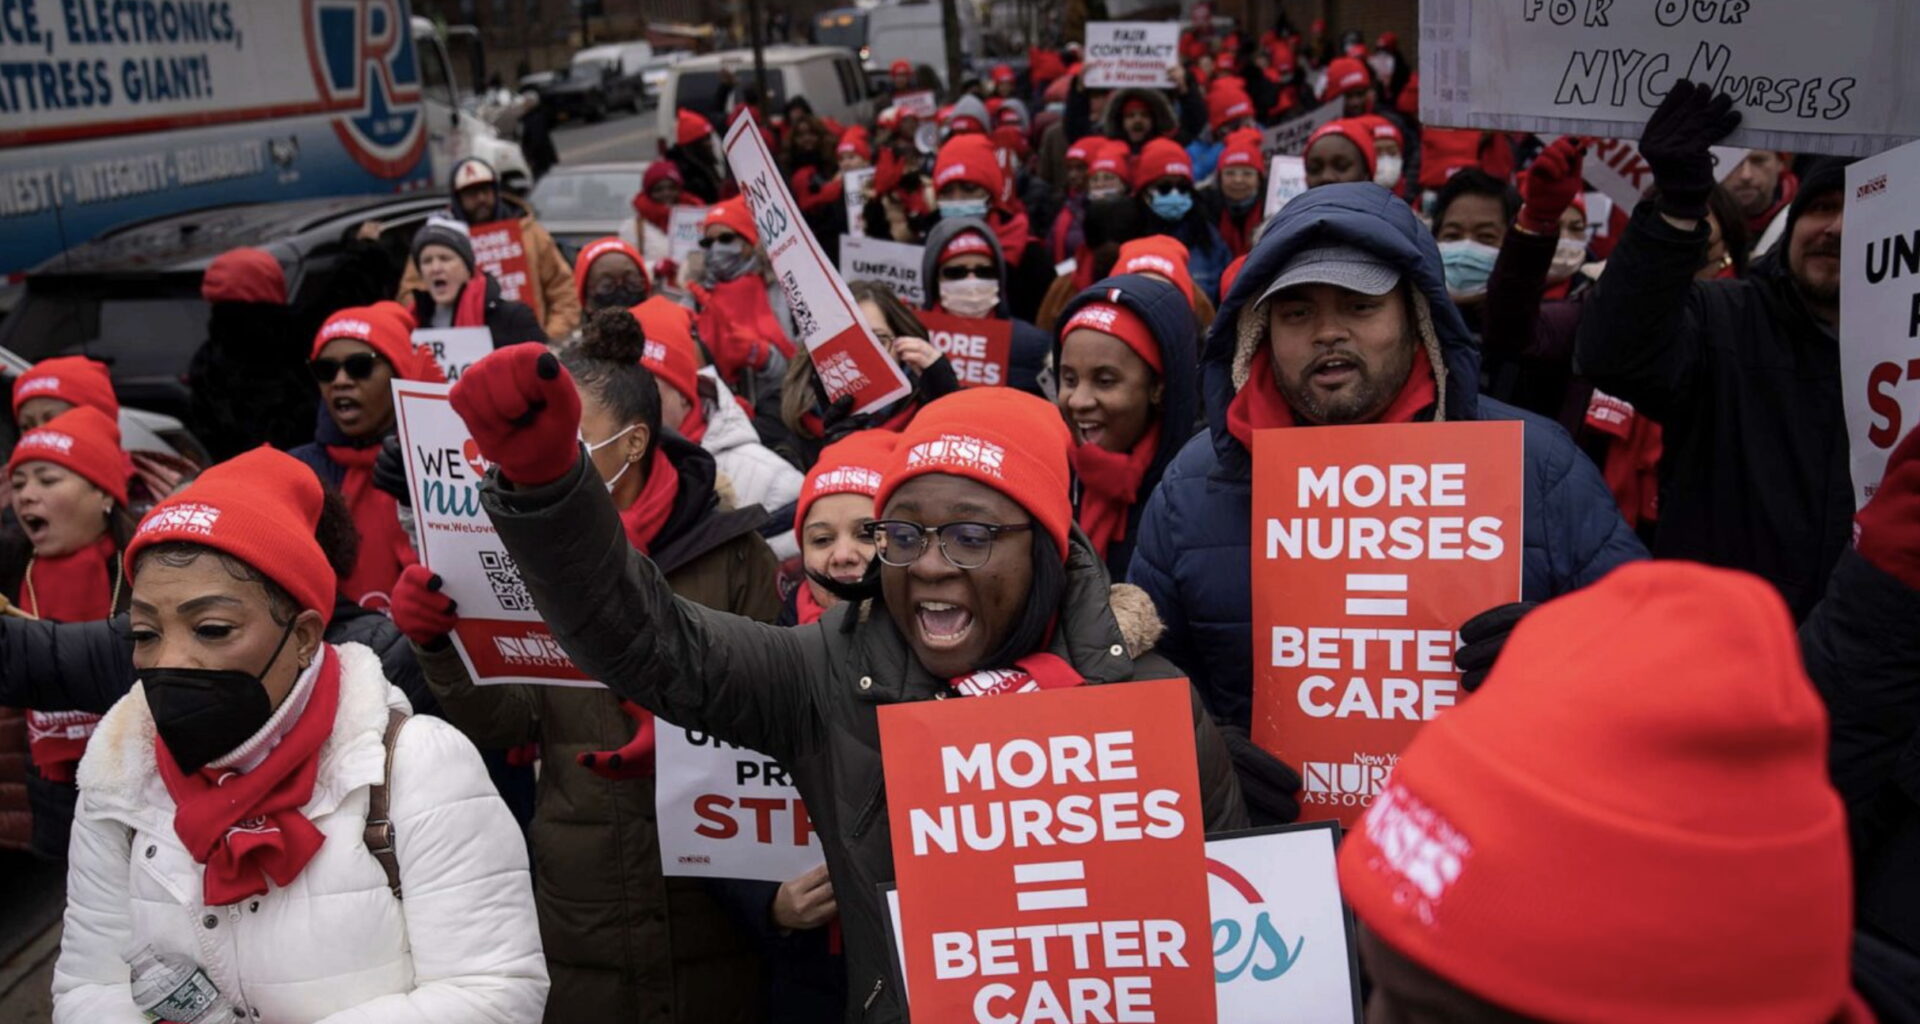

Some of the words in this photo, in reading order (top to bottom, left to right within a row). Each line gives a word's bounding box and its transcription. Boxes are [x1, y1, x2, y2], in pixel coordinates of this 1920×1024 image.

[62, 0, 243, 50] ELECTRONICS,
[1656, 0, 1751, 27] OUR
[1089, 44, 1174, 58] CONTRACT
[121, 54, 213, 102] GIANT!
[1554, 49, 1671, 108] NYC
[852, 259, 918, 283] UNFAIR
[417, 445, 465, 480] WE
[908, 440, 1004, 469] NURSES
[1297, 462, 1467, 508] MORE
[1265, 515, 1505, 561] NURSES
[1271, 626, 1467, 673] BETTE
[940, 730, 1139, 794] MORE
[1353, 752, 1386, 766] New
[908, 788, 1186, 856] NURSES
[931, 919, 1191, 980] BETTER
[972, 976, 1156, 1024] CARE
